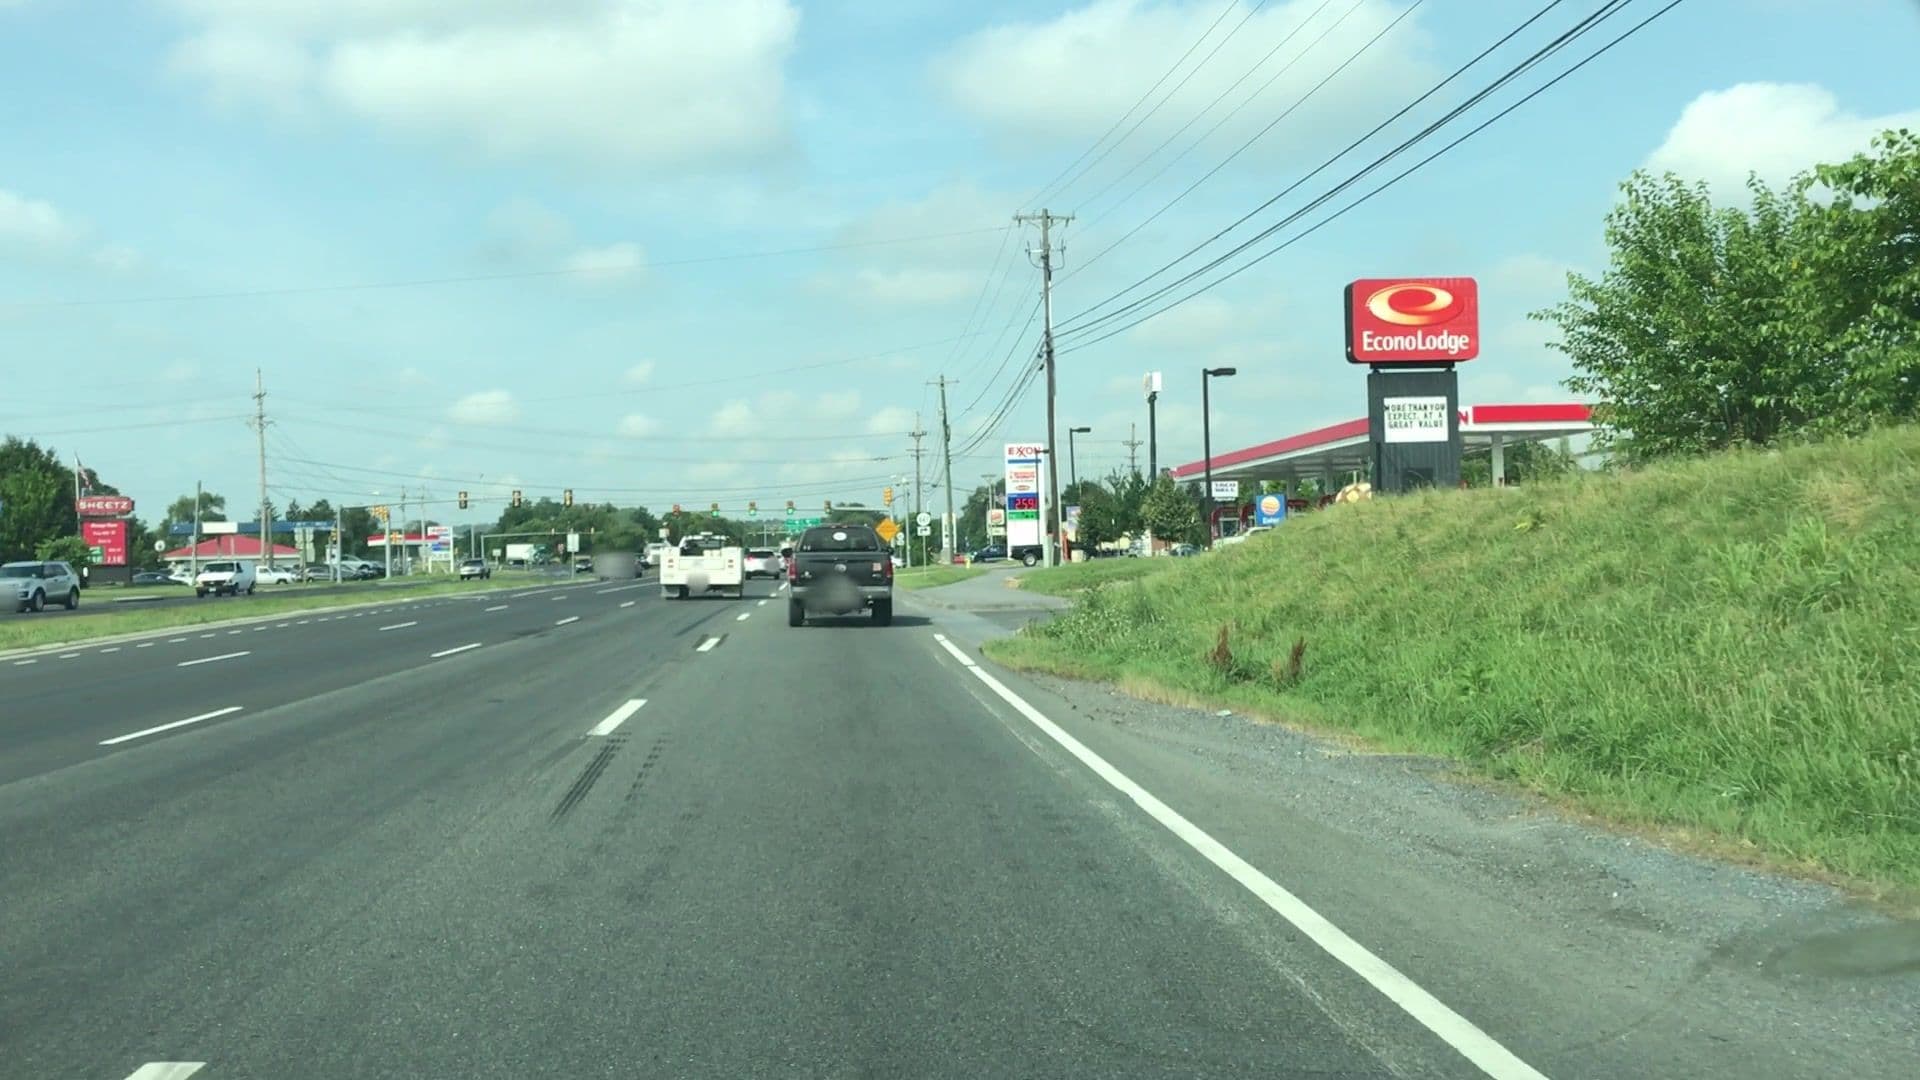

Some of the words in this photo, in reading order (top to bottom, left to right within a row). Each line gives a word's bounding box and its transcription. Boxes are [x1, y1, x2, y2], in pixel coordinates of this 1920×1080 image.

[1363, 330, 1469, 355] EconoLodge
[1408, 403, 1428, 411] THAN
[1430, 403, 1445, 411] YOU
[1424, 411, 1433, 419] AT
[1457, 410, 1469, 425] N
[1388, 420, 1413, 429] GREAT
[1418, 419, 1443, 428] VALUE
[1008, 446, 1041, 457] EXXON
[79, 501, 128, 509] SHEETZ
